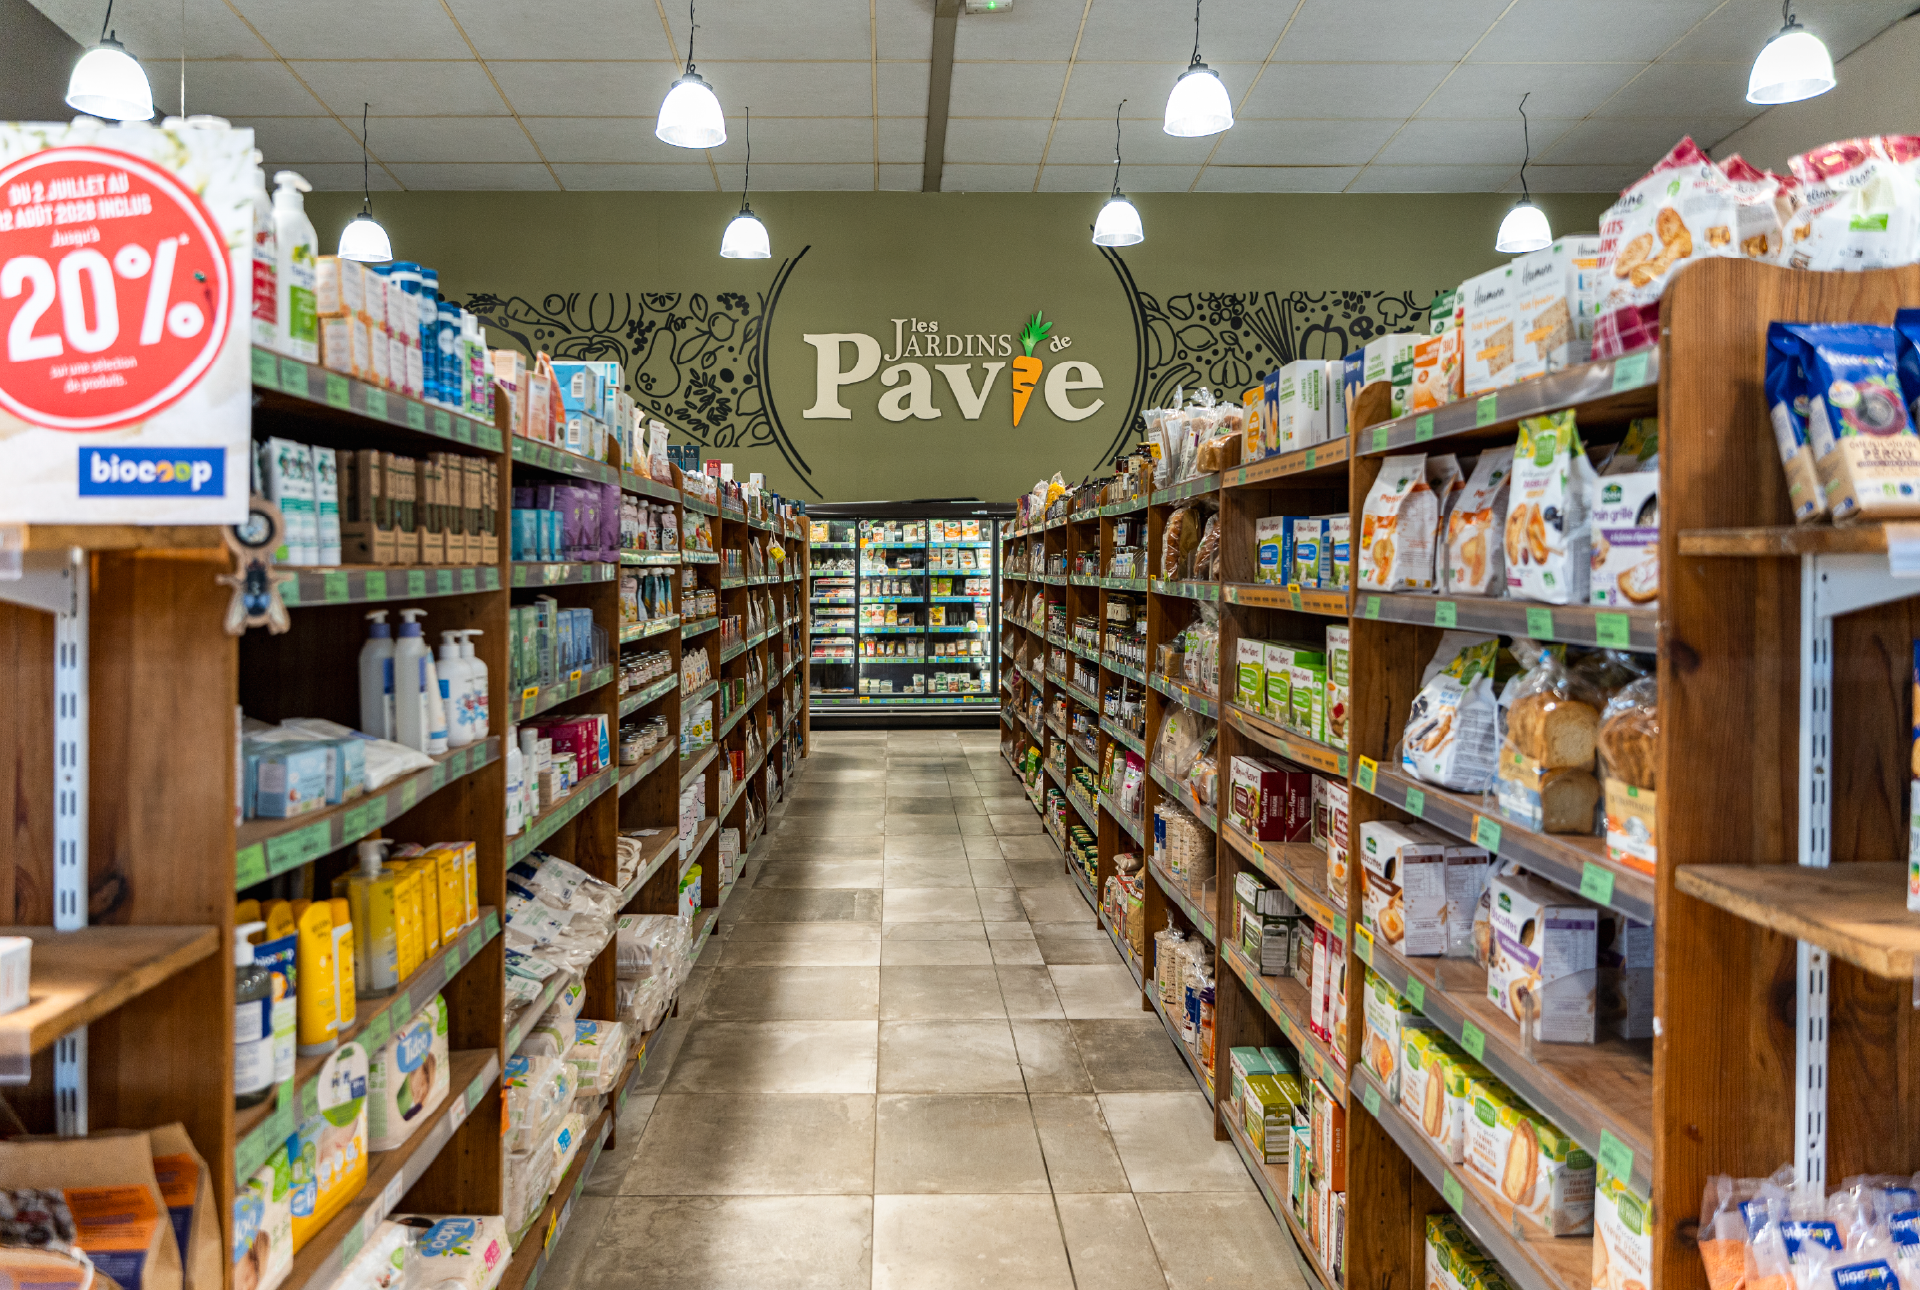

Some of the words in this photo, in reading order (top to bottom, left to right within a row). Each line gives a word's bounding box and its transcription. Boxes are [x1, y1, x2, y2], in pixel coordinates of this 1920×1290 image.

[8, 182, 31, 207] DU
[31, 181, 45, 203] 2
[47, 173, 105, 202] JUILLET
[106, 171, 129, 194] AU
[14, 202, 53, 230] AOÛT
[97, 193, 152, 220] INCLUS
[50, 225, 100, 248] Jusqu'à
[911, 318, 939, 333] les
[1049, 333, 1072, 354] de
[68, 362, 90, 377] une
[91, 355, 137, 374] sélection
[803, 332, 1105, 427] Pavie
[91, 450, 213, 492] biocoop
[431, 1221, 472, 1249] Tidoo
